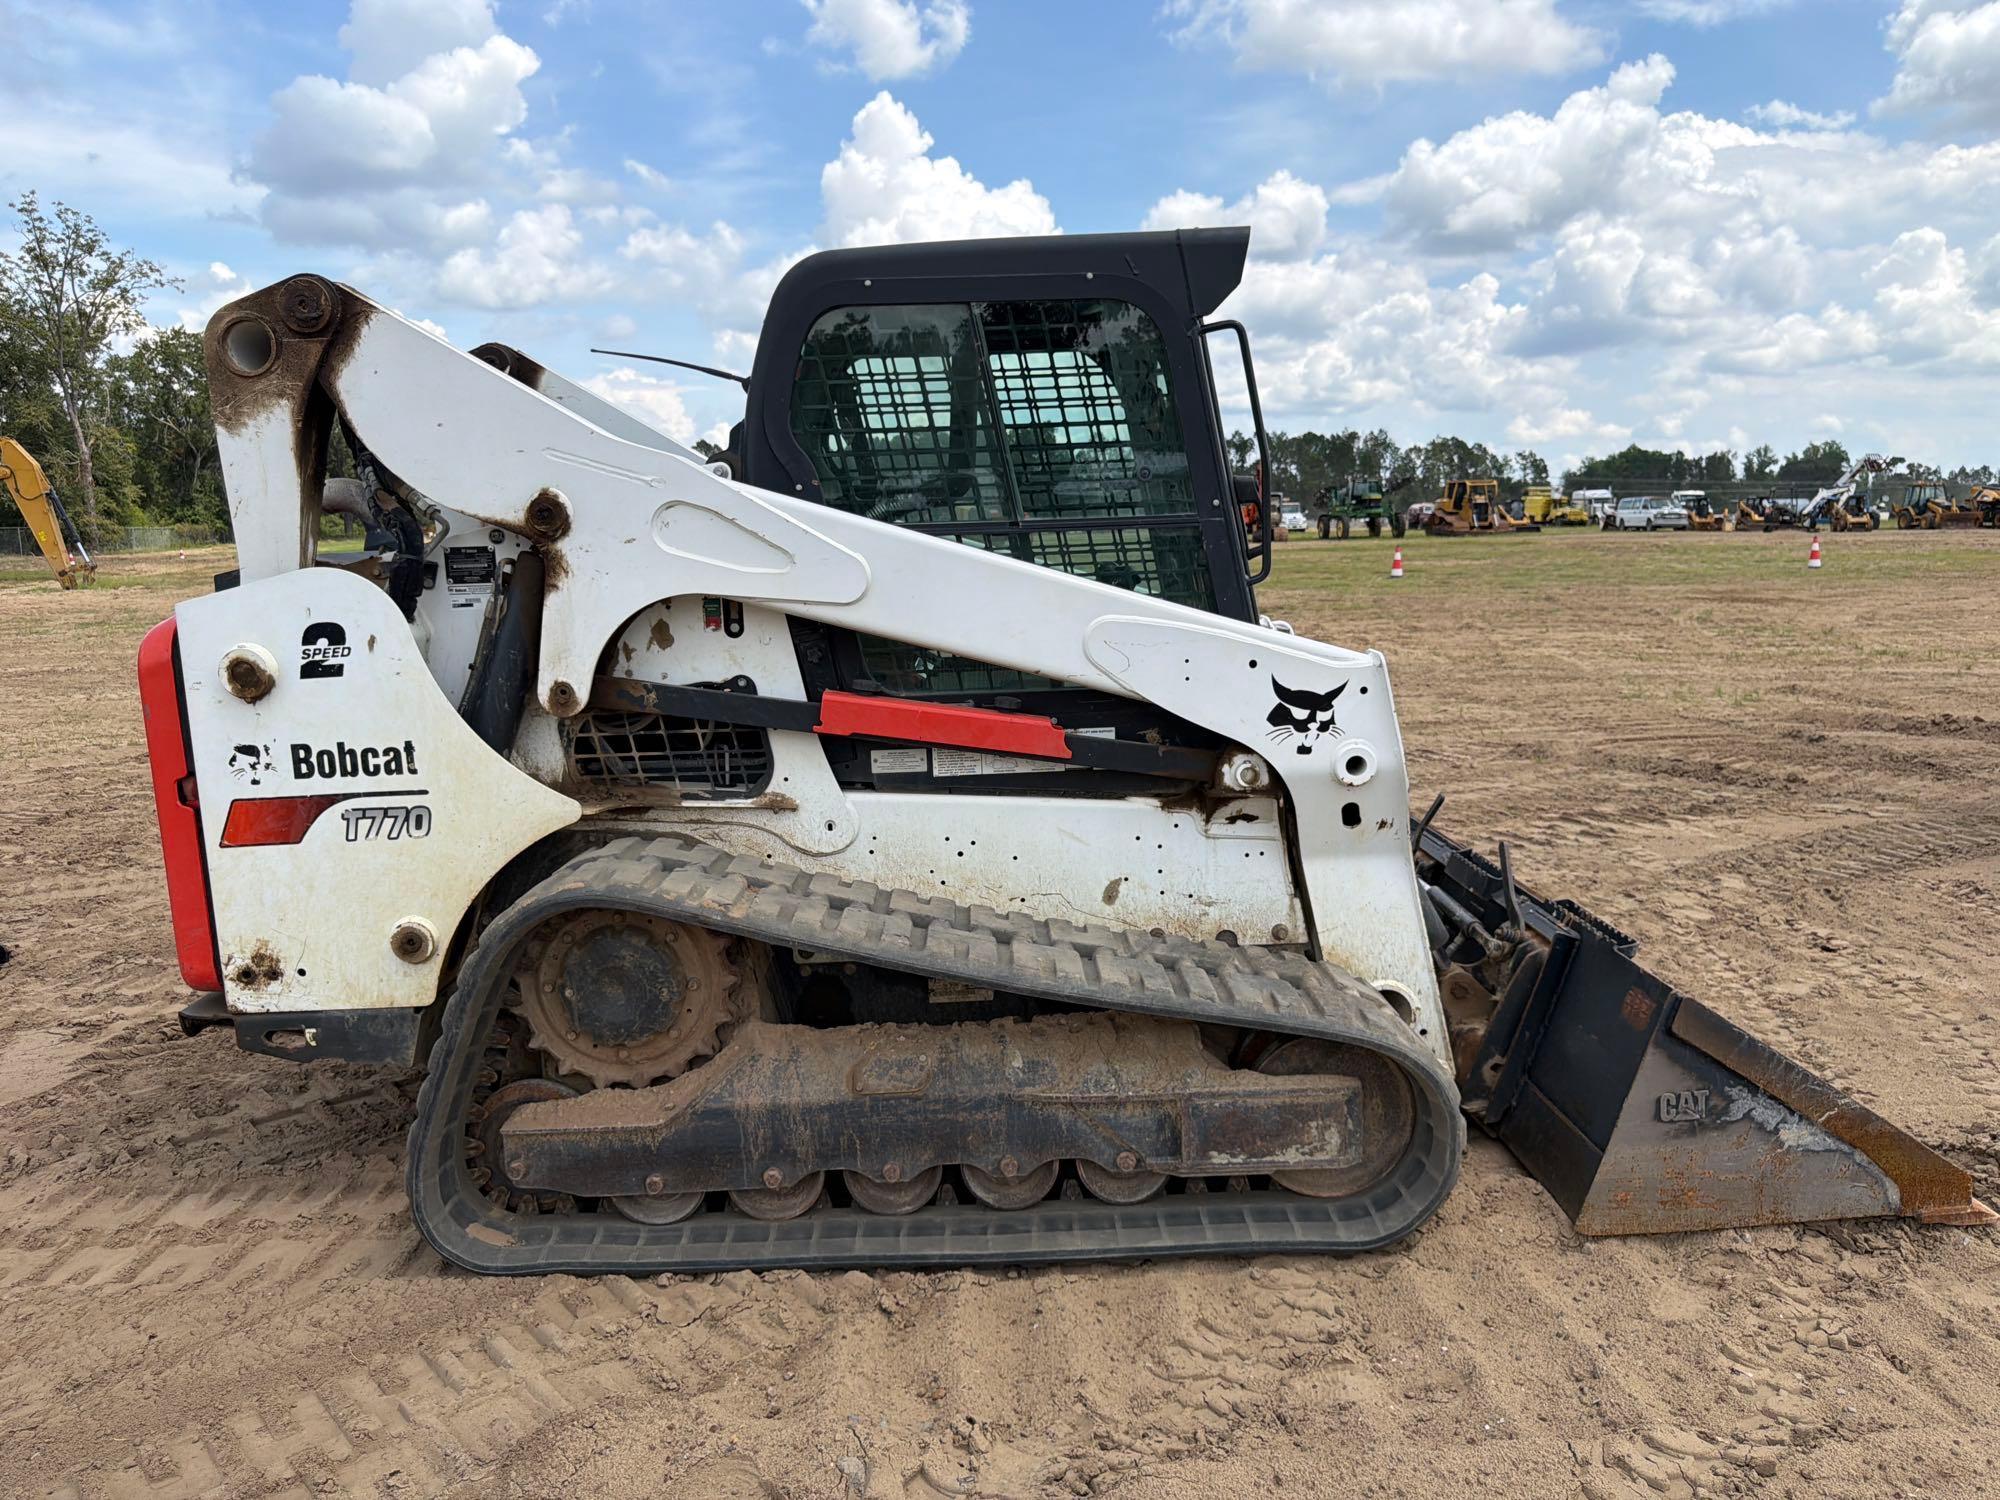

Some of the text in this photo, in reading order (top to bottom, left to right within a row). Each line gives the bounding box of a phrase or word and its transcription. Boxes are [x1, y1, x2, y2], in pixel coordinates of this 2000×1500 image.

[300, 622, 346, 679] 2
[301, 647, 352, 660] SPEED
[290, 740, 418, 779] Bobcat
[341, 805, 431, 842] T770
[1657, 1089, 1709, 1122] CAT
